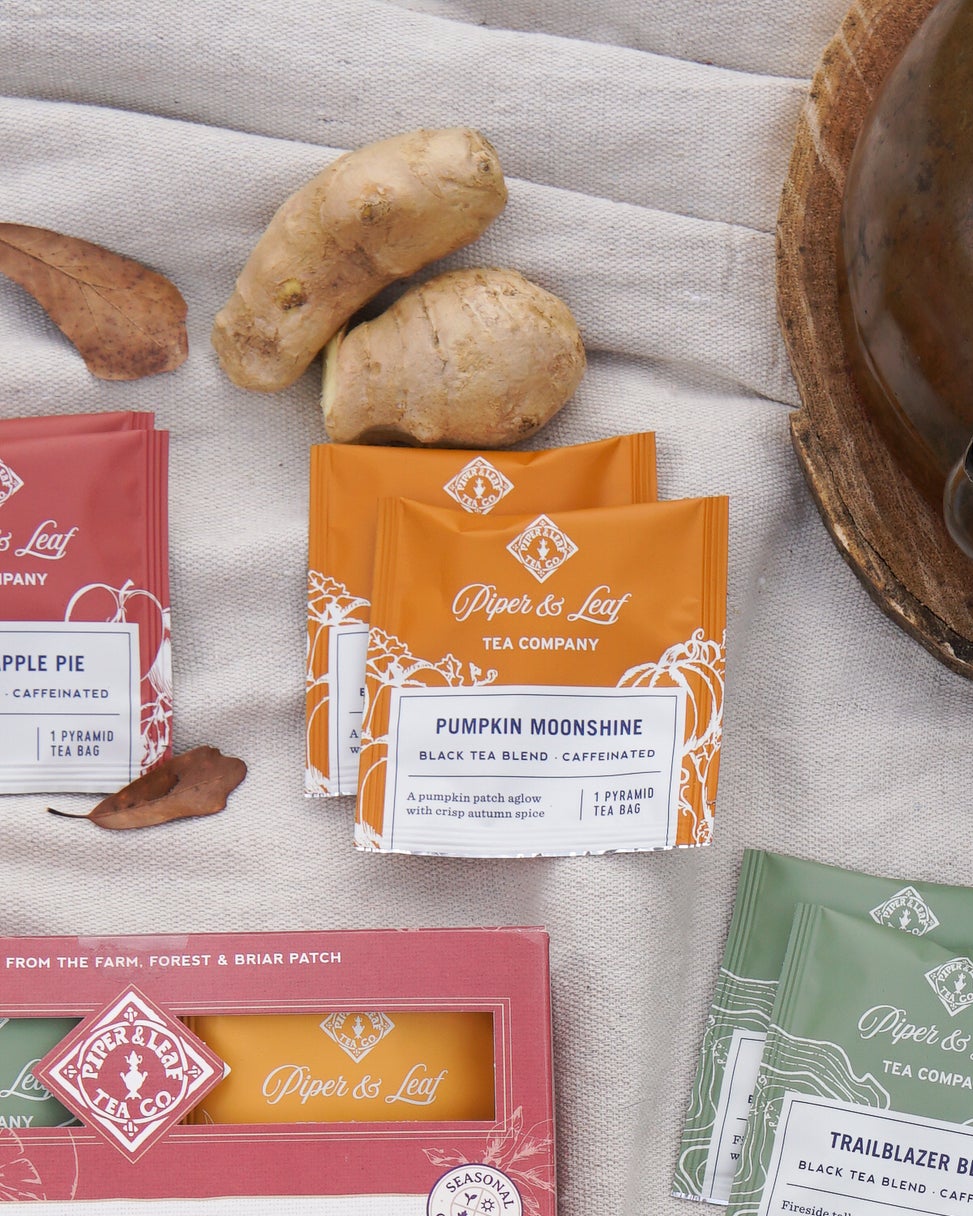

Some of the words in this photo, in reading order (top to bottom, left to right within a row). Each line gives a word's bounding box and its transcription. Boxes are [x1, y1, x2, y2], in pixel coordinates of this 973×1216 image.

[14, 520, 79, 560] Leaf
[520, 528, 542, 551] PIPER
[524, 554, 542, 569] TEA
[452, 583, 533, 622] Piper
[535, 593, 565, 617] &
[567, 585, 632, 625] Leaf
[483, 637, 514, 650] TEA
[518, 637, 600, 652] COMPANY
[0, 655, 48, 672] PPLE
[56, 655, 85, 672] PIE
[13, 688, 109, 698] CAFFEINATED
[436, 717, 522, 735] PUMPKIN
[530, 718, 644, 736] MOONSHINE
[50, 730, 55, 741] 1
[62, 730, 114, 742] PYRAMID
[51, 745, 72, 756] TEA
[77, 745, 100, 756] BAG
[419, 751, 464, 761] BLACK
[470, 751, 496, 760] TEA
[502, 752, 548, 762] BLEND
[562, 749, 656, 762] CAFFEINATED
[407, 792, 416, 801] A
[418, 792, 470, 804] pumpkin
[473, 793, 506, 806] patch
[508, 794, 542, 806] aglow
[594, 792, 599, 802] 1
[604, 788, 654, 802] PYRAMID
[406, 806, 432, 816] with
[436, 806, 465, 819] crisp
[468, 808, 512, 818] autumn
[514, 808, 545, 821] spice
[594, 804, 614, 816] TEA
[620, 803, 641, 815] BAG
[6, 956, 51, 969] FROM
[57, 956, 88, 968] THE
[150, 954, 212, 967] FOREST
[218, 954, 228, 966] &
[234, 952, 284, 966] BRIAR
[289, 952, 342, 964] PATCH
[940, 986, 955, 1002] TEA
[858, 1004, 940, 1045] Piper
[941, 1030, 971, 1052] &
[340, 1033, 357, 1048] TEA
[82, 1026, 130, 1079] PIPER
[132, 1026, 146, 1046] &
[882, 1060, 912, 1078] TEA
[0, 1058, 54, 1102] Le
[262, 1064, 349, 1105] Piper
[352, 1074, 382, 1099] &
[384, 1063, 448, 1106] Leaf
[93, 1088, 130, 1118] TEA
[140, 1090, 176, 1116] CO.
[830, 1131, 950, 1172] TRAILBLAZER
[798, 1160, 844, 1178] BLACK
[850, 1170, 876, 1184] TEA
[882, 1177, 926, 1194] BLEND
[446, 1172, 514, 1210] SEASONAL
